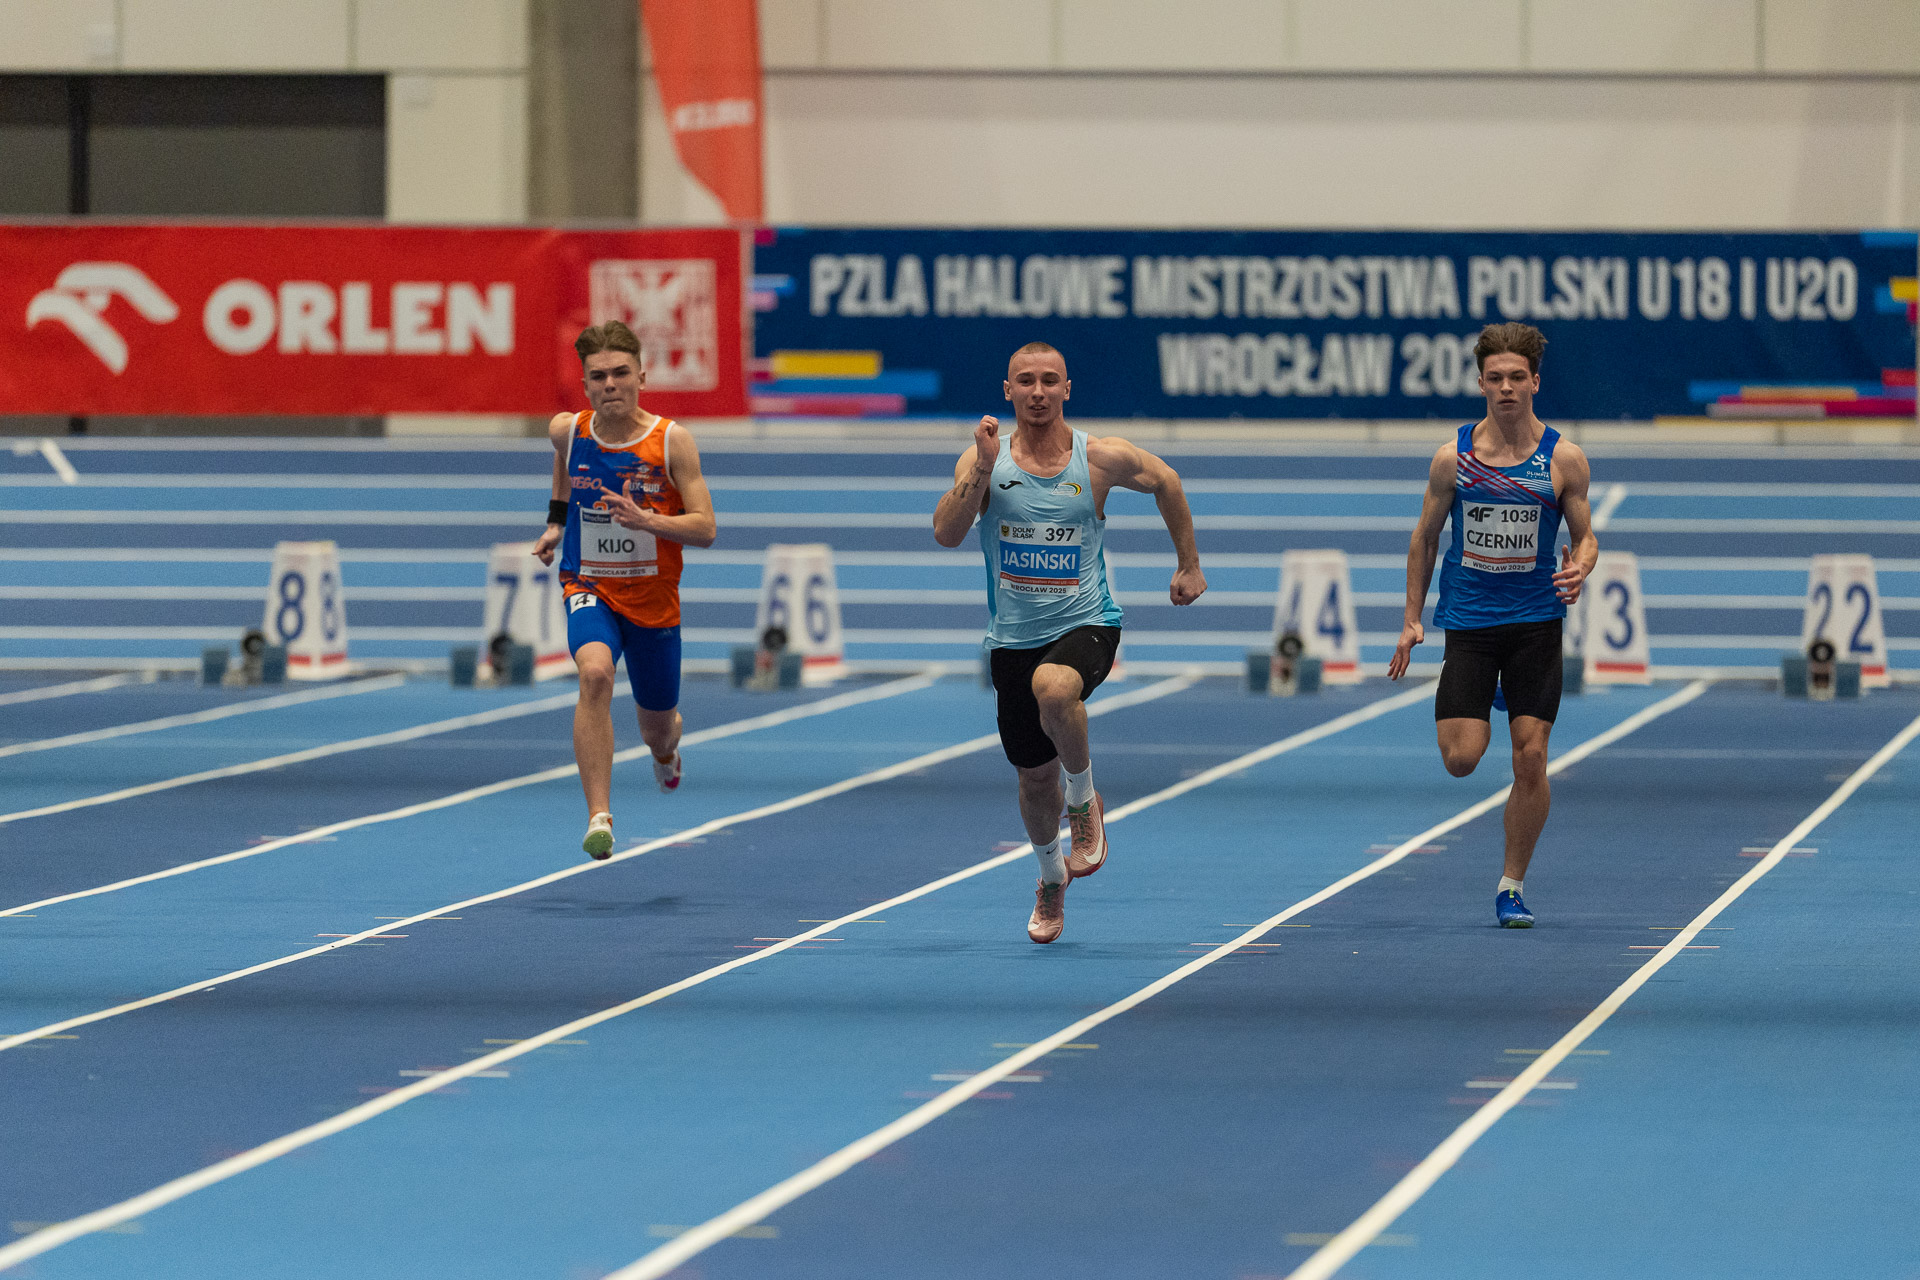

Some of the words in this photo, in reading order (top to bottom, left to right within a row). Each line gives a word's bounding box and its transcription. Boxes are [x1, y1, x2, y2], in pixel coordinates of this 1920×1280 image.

[809, 254, 928, 317] PZLA
[934, 255, 1127, 318] HALOWE
[1133, 256, 1461, 319] MISTRZOSTWA
[1469, 256, 1629, 320] POLSKI
[1637, 257, 1732, 321] U18
[1739, 258, 1757, 320] I
[1765, 257, 1858, 321] U20
[203, 278, 514, 356] ORLEN
[1157, 332, 1395, 397] WROCŁAW
[1401, 332, 1480, 398] 202
[629, 482, 660, 493] UX-BUD
[1467, 506, 1495, 522] 4F
[1501, 509, 1538, 523] 1038
[598, 539, 635, 553] KIJO
[1003, 549, 1076, 570] JASIŃSKI
[1045, 527, 1075, 542] 397
[1466, 530, 1534, 549] CZERNIK
[1010, 583, 1048, 593] WROCŁAW
[1473, 561, 1508, 571] WROCŁAW
[276, 571, 306, 642] 8
[496, 573, 518, 634] 7
[574, 593, 590, 606] 4
[804, 573, 831, 644] 6
[1316, 581, 1345, 650] 4
[1603, 579, 1634, 651] 3
[1813, 583, 1833, 638] 2
[1846, 582, 1875, 653] 2
